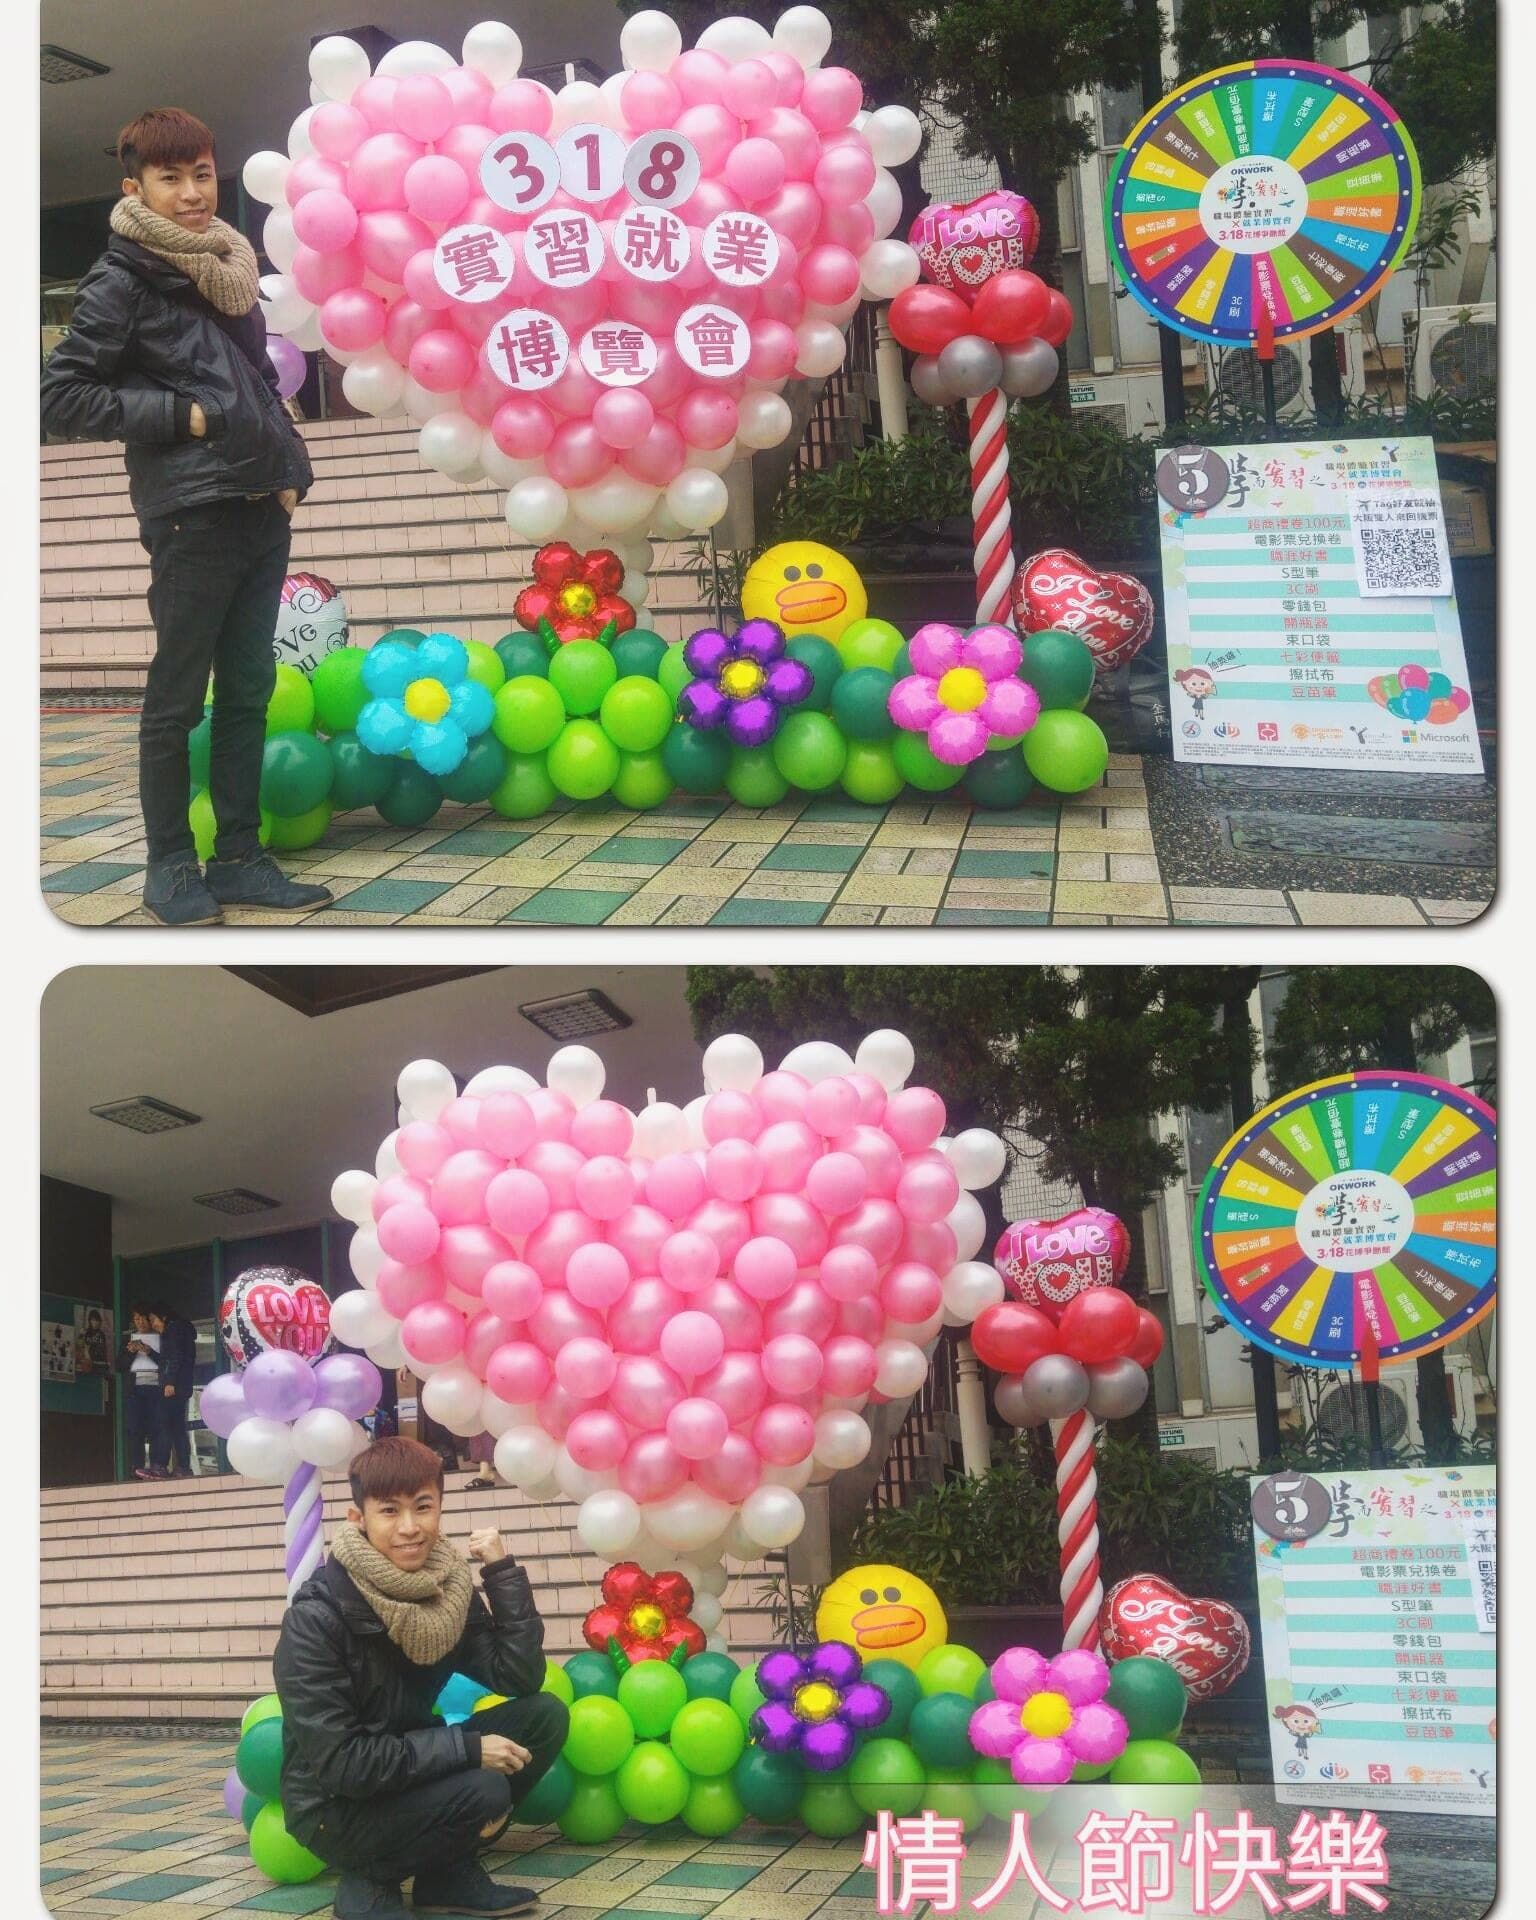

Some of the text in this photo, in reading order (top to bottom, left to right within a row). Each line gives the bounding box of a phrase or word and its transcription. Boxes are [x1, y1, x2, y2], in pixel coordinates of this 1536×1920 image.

[493, 134, 685, 203] 318
[1230, 166, 1274, 175] OKWORK
[441, 213, 768, 296] 實習就業
[920, 238, 1024, 288] YOU
[497, 313, 739, 383] 博覽會
[1178, 454, 1208, 495] 5
[1281, 566, 1319, 578] S型筆
[1285, 633, 1330, 646] 束口袋
[1289, 668, 1334, 681] 擦拭布
[1420, 732, 1471, 743] Microsoft
[1329, 1180, 1376, 1191] OKWORK
[1006, 1256, 1113, 1305] YOU
[255, 1293, 329, 1324] LOVE
[1275, 1481, 1308, 1523] 5
[1391, 1599, 1433, 1611] S型筆
[1392, 1634, 1442, 1647] 零錢包
[1397, 1670, 1447, 1684] 束口袋
[1402, 1705, 1452, 1720] 擦拭布
